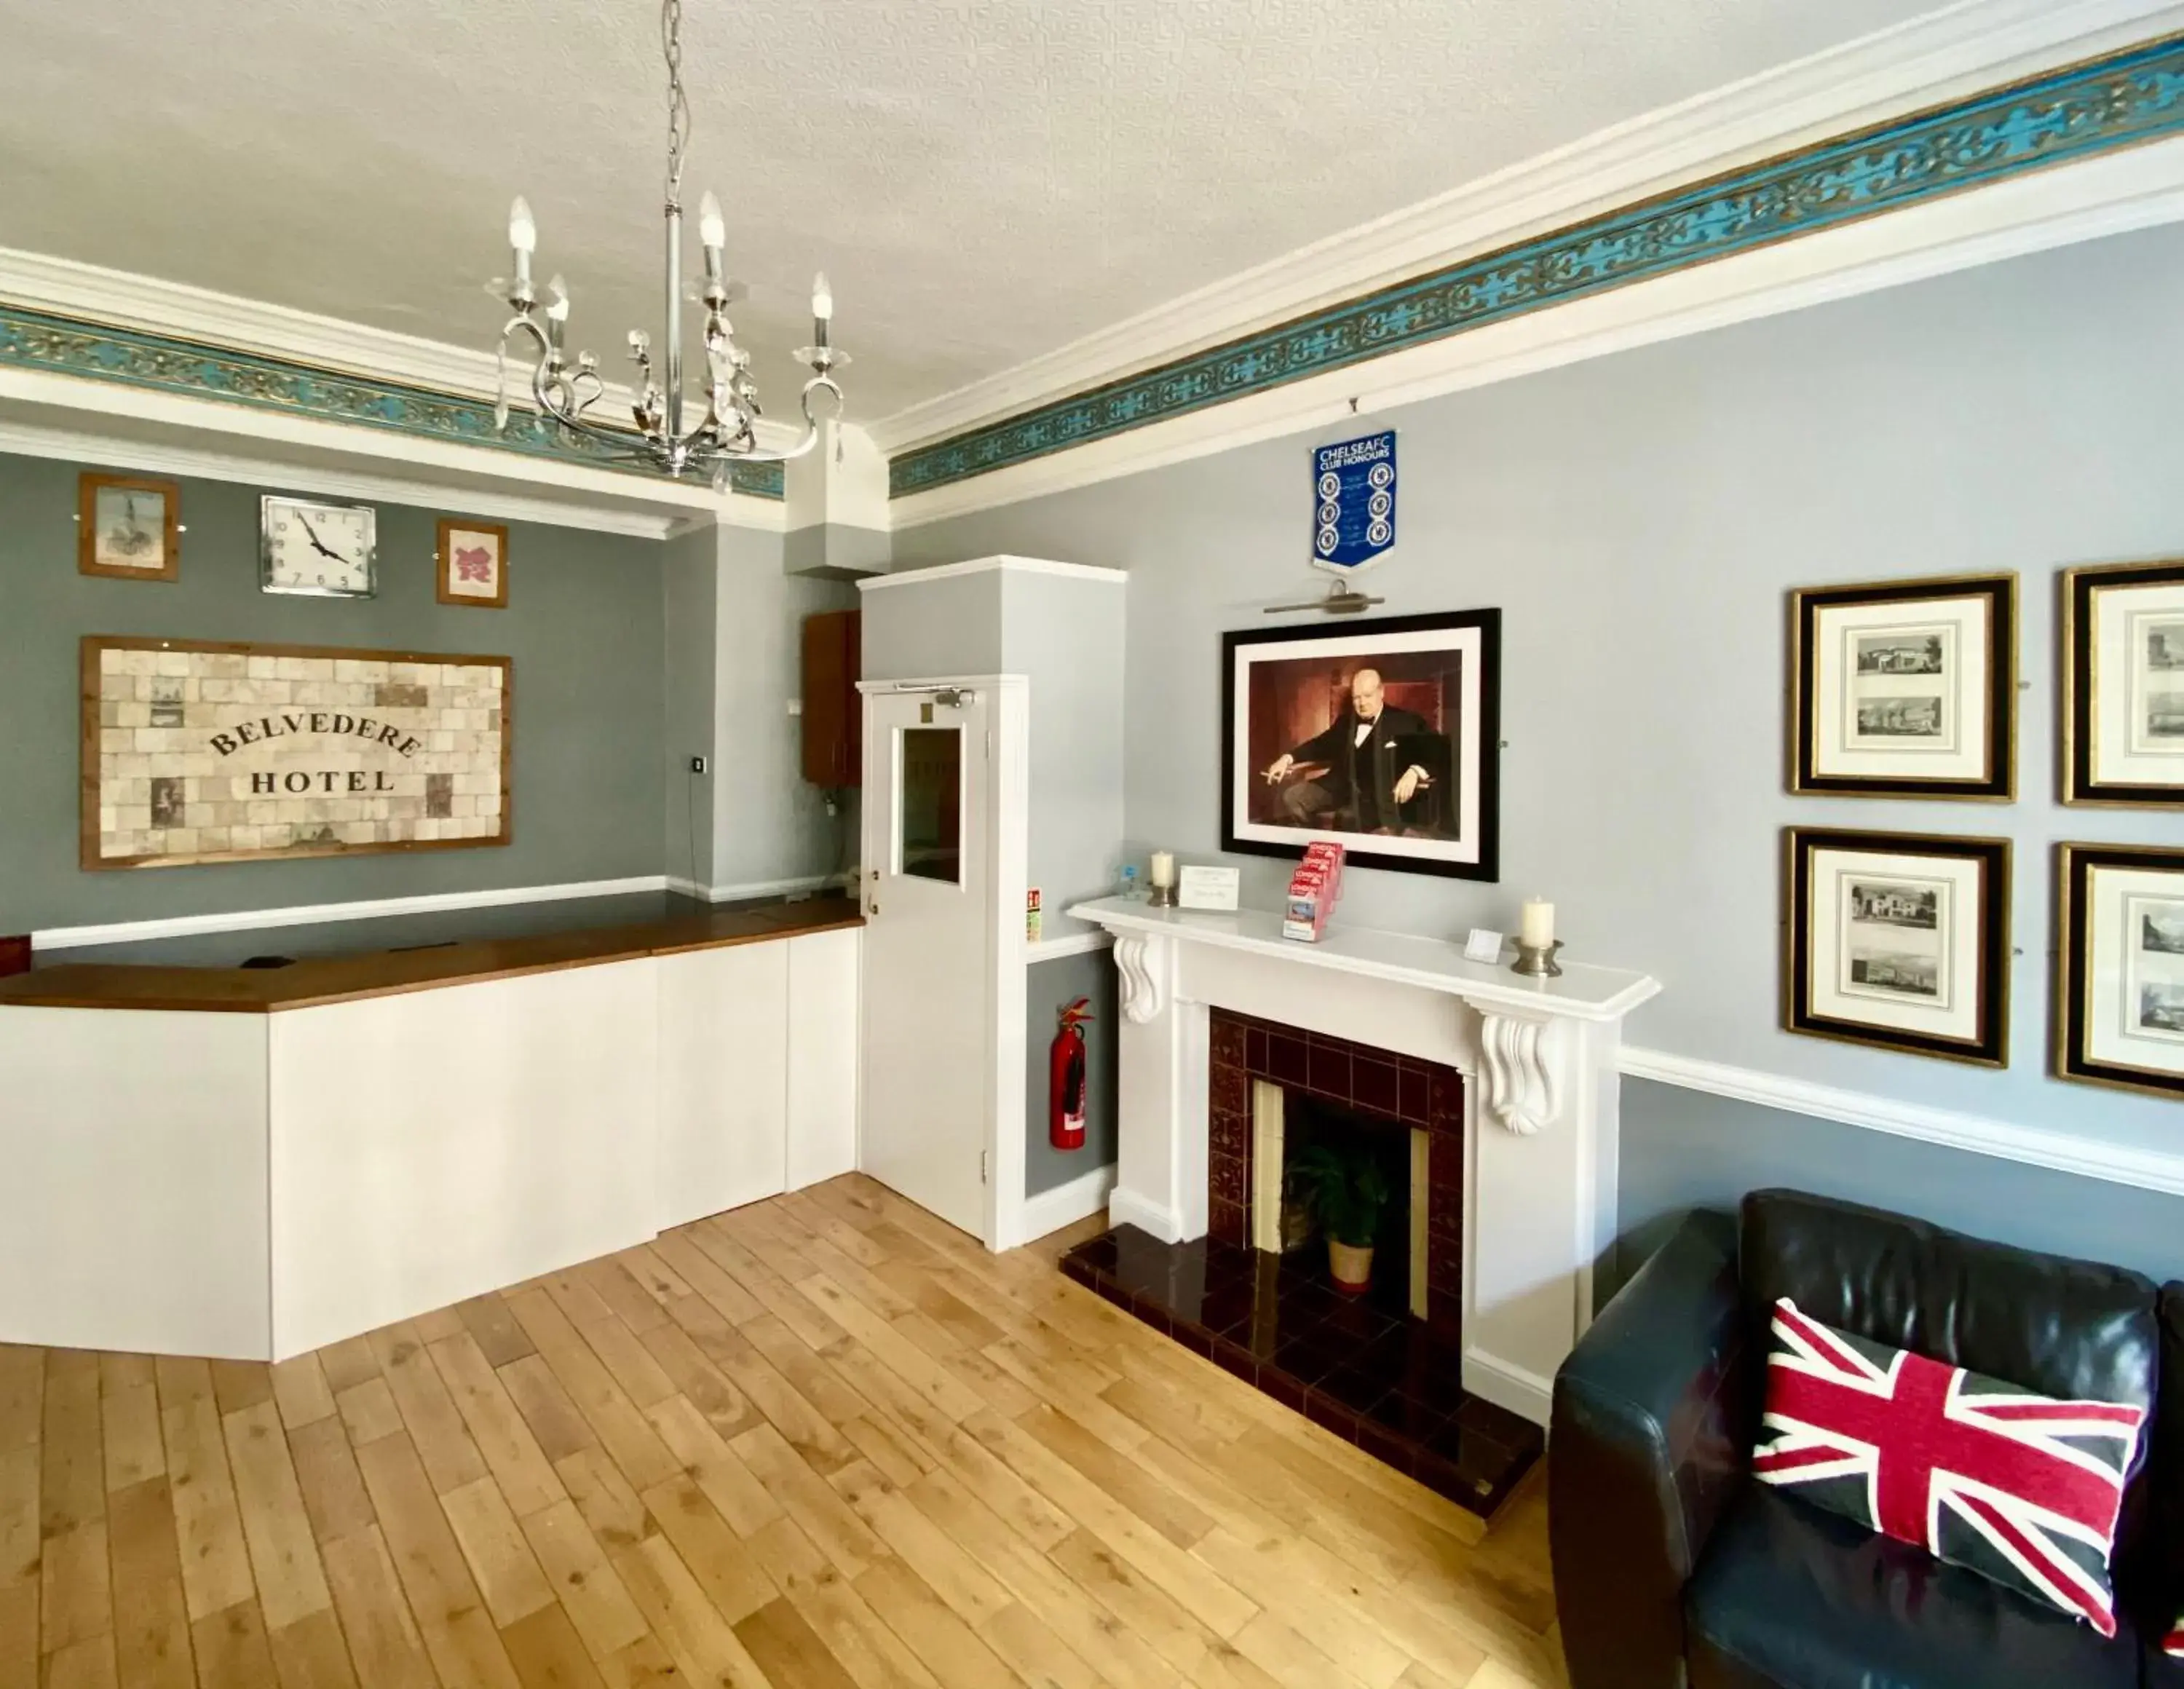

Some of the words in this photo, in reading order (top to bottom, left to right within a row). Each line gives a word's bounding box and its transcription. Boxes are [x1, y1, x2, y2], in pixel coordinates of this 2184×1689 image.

[1319, 459, 1342, 471] CLUB
[1343, 448, 1390, 466] HONOURS
[315, 513, 326, 523] 12
[354, 529, 363, 540] 2
[355, 547, 363, 557] 3
[354, 563, 363, 572] 4
[293, 571, 302, 585] 7
[317, 574, 325, 585] 6
[340, 575, 349, 588] 5
[209, 712, 422, 759] BELVEDERE
[250, 770, 395, 794] HOTEL
